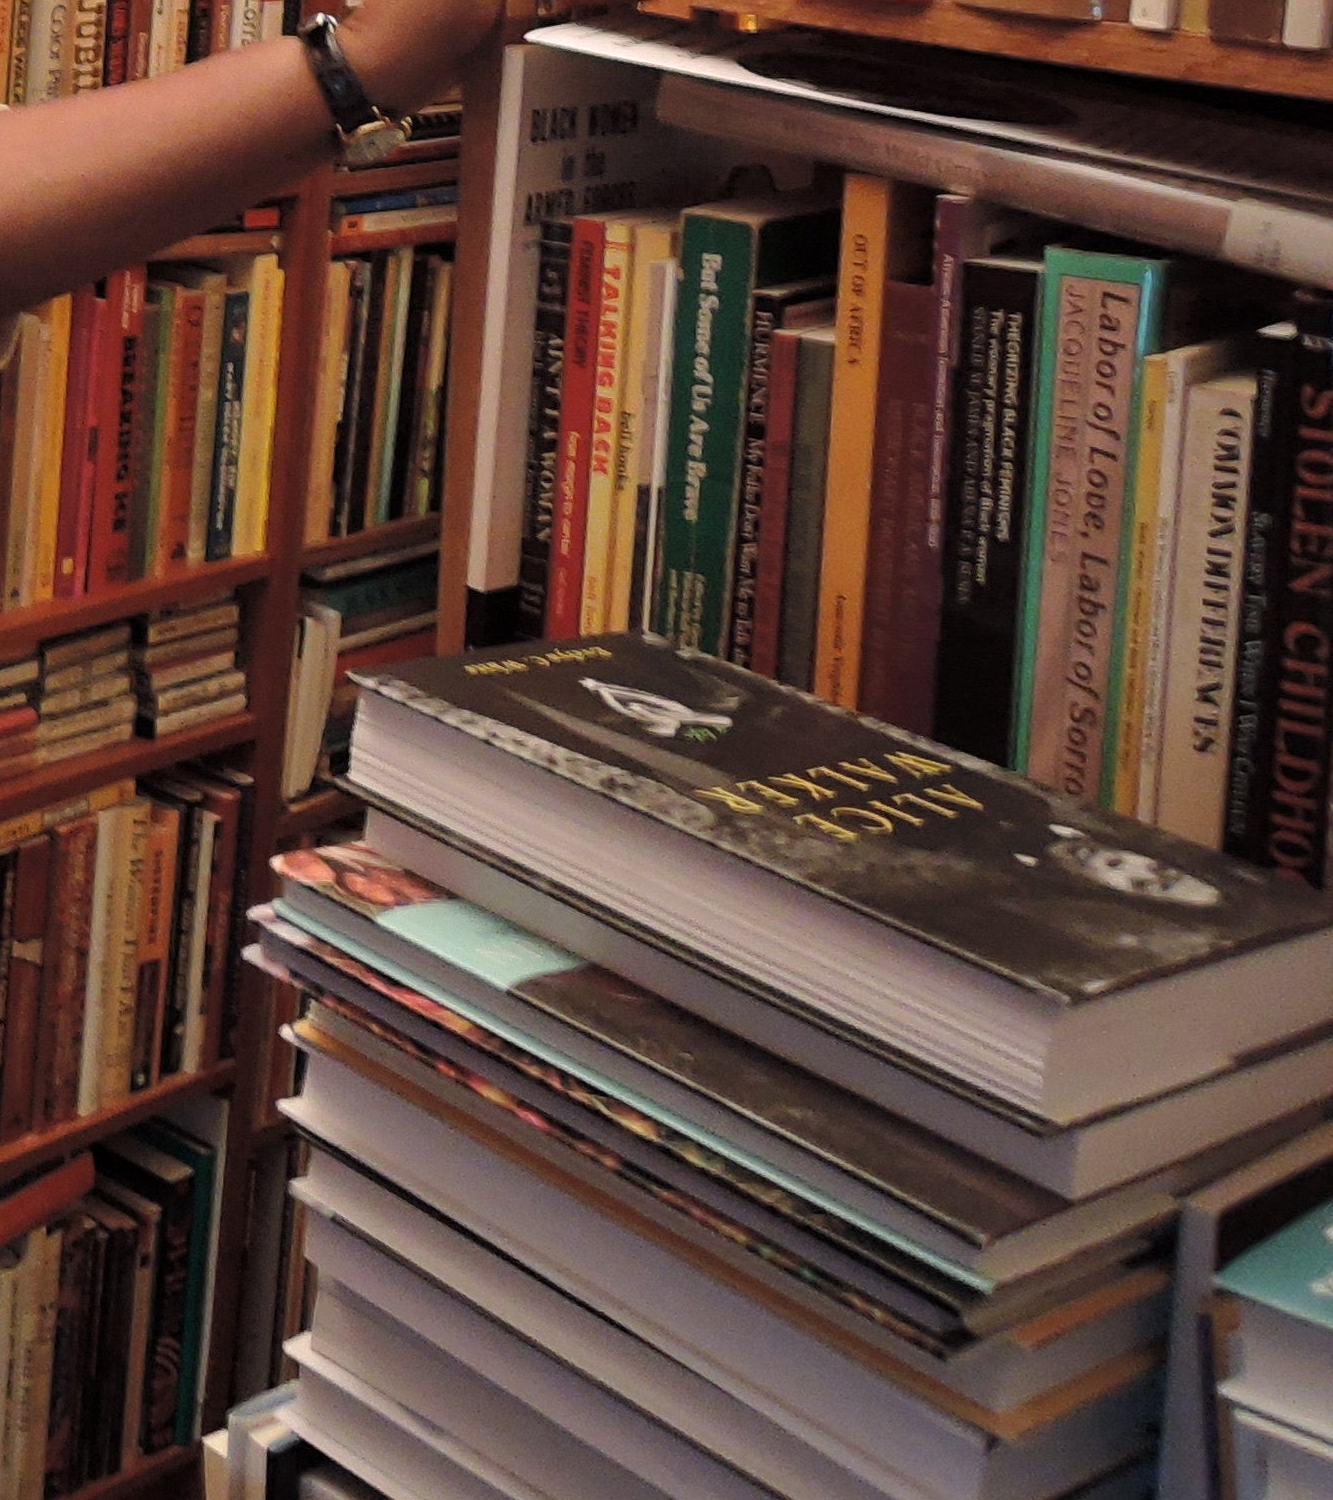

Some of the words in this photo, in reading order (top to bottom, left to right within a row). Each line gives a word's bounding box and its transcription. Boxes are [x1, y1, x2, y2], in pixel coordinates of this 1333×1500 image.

[701, 252, 722, 291] But
[850, 233, 869, 271] OUT
[850, 277, 867, 298] OF
[596, 264, 622, 388] TALKING
[694, 294, 720, 355] Some
[846, 302, 867, 367] AFRICA
[1096, 289, 1129, 397] Labor
[693, 356, 715, 380] of
[1051, 283, 1084, 461] JACQUELINE
[690, 384, 713, 416] Us
[1088, 403, 1120, 438] of
[591, 396, 615, 476] BACK
[688, 418, 711, 457] Are
[683, 460, 708, 523] Brave
[1047, 471, 1074, 565] JONES
[1078, 446, 1116, 539] Love,
[1287, 384, 1333, 597] STOLEN
[1073, 552, 1114, 655] Labor
[1066, 662, 1103, 694] of
[1062, 705, 1096, 796] Sorro
[699, 751, 954, 813] WALKER
[789, 783, 986, 845] ALICE
